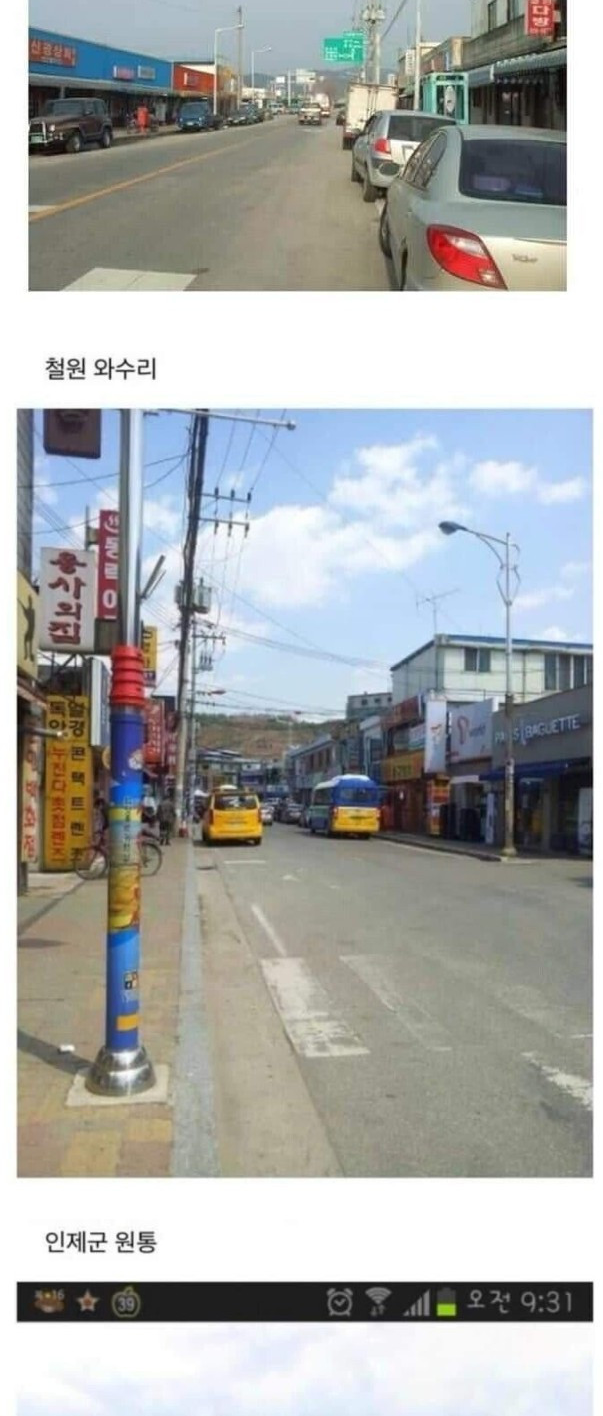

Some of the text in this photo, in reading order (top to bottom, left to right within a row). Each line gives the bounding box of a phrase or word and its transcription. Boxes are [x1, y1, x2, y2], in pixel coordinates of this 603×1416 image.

[531, 5, 549, 27] 다방
[525, 713, 581, 737] BAGUETTE
[467, 1288, 573, 1314] 오전 9:31
